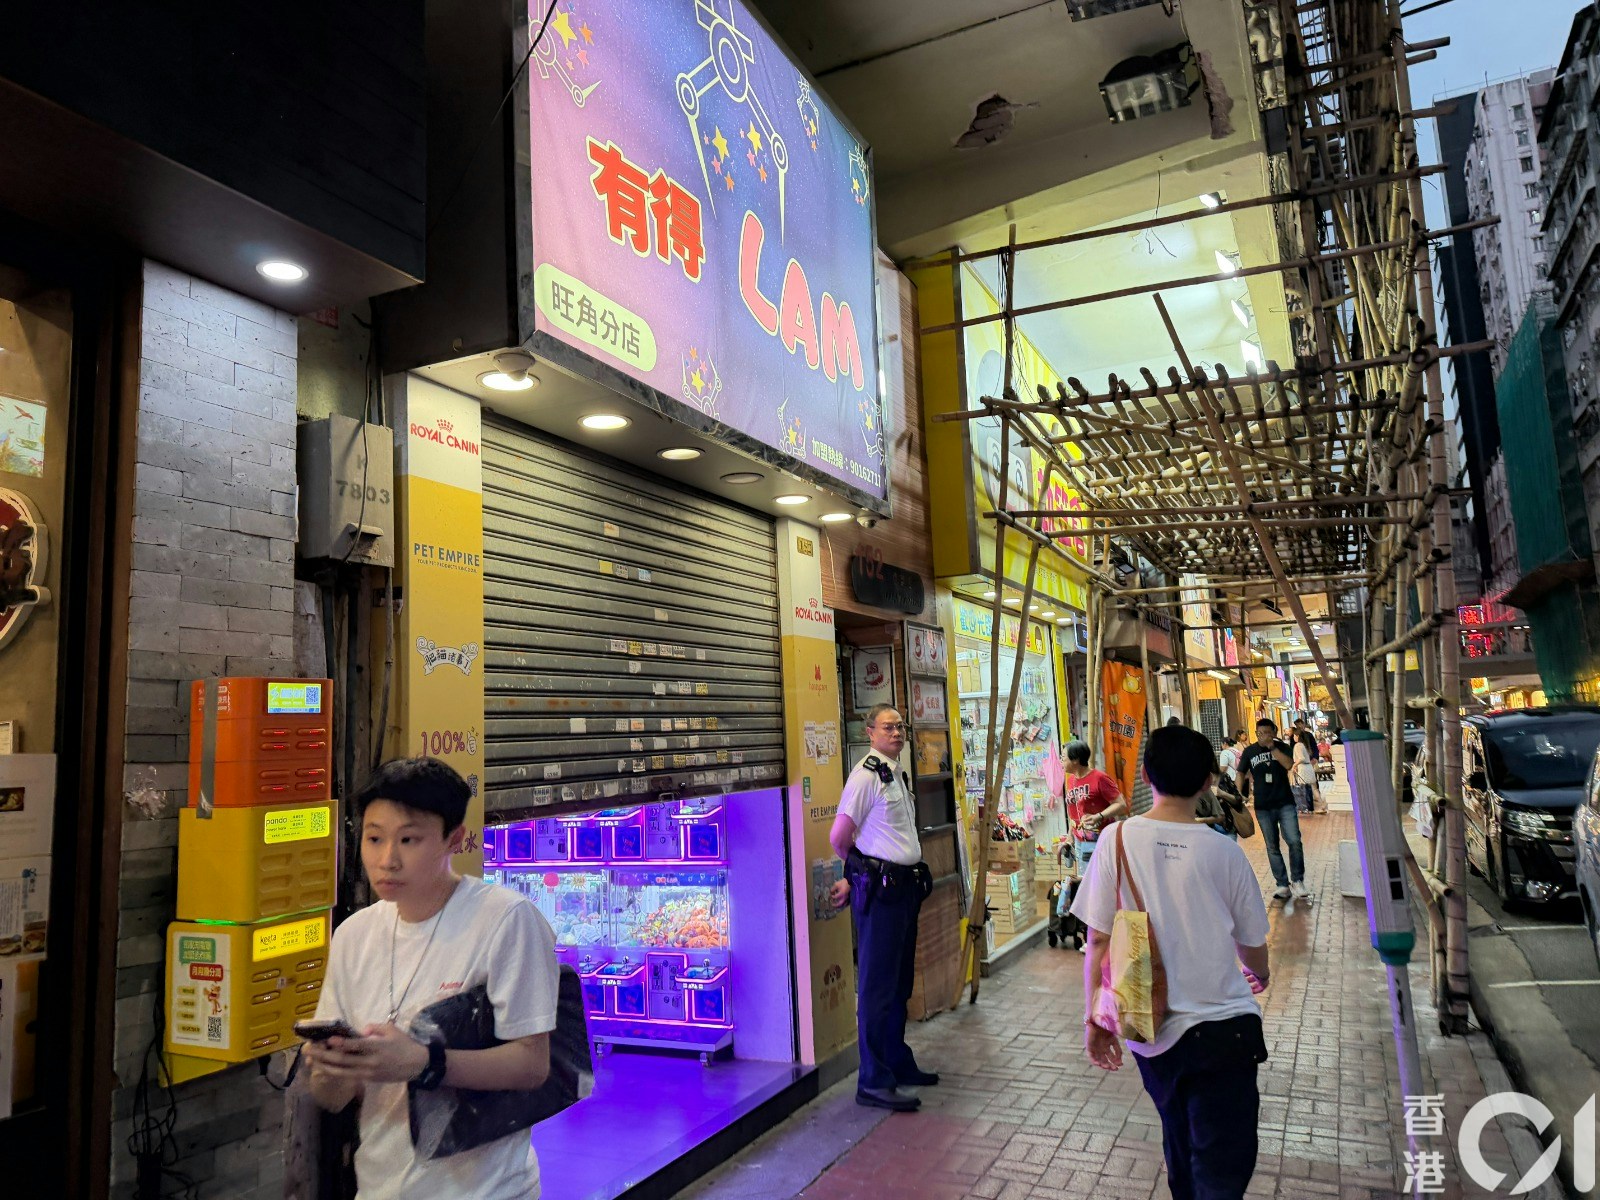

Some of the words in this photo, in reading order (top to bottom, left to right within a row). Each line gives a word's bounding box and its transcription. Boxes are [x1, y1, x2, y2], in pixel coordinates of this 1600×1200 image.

[585, 135, 706, 285] 有得
[738, 209, 865, 392] LAM
[551, 280, 641, 359] 旺角分店
[410, 422, 444, 446] ROYAL
[446, 434, 479, 456] CANIN
[335, 479, 391, 505] 7803
[413, 542, 434, 560] PET
[438, 546, 481, 568] EMPIRE
[795, 606, 814, 621] ROYAL
[814, 611, 833, 625] CANIN
[420, 730, 465, 758] 100%
[810, 807, 820, 820] PET
